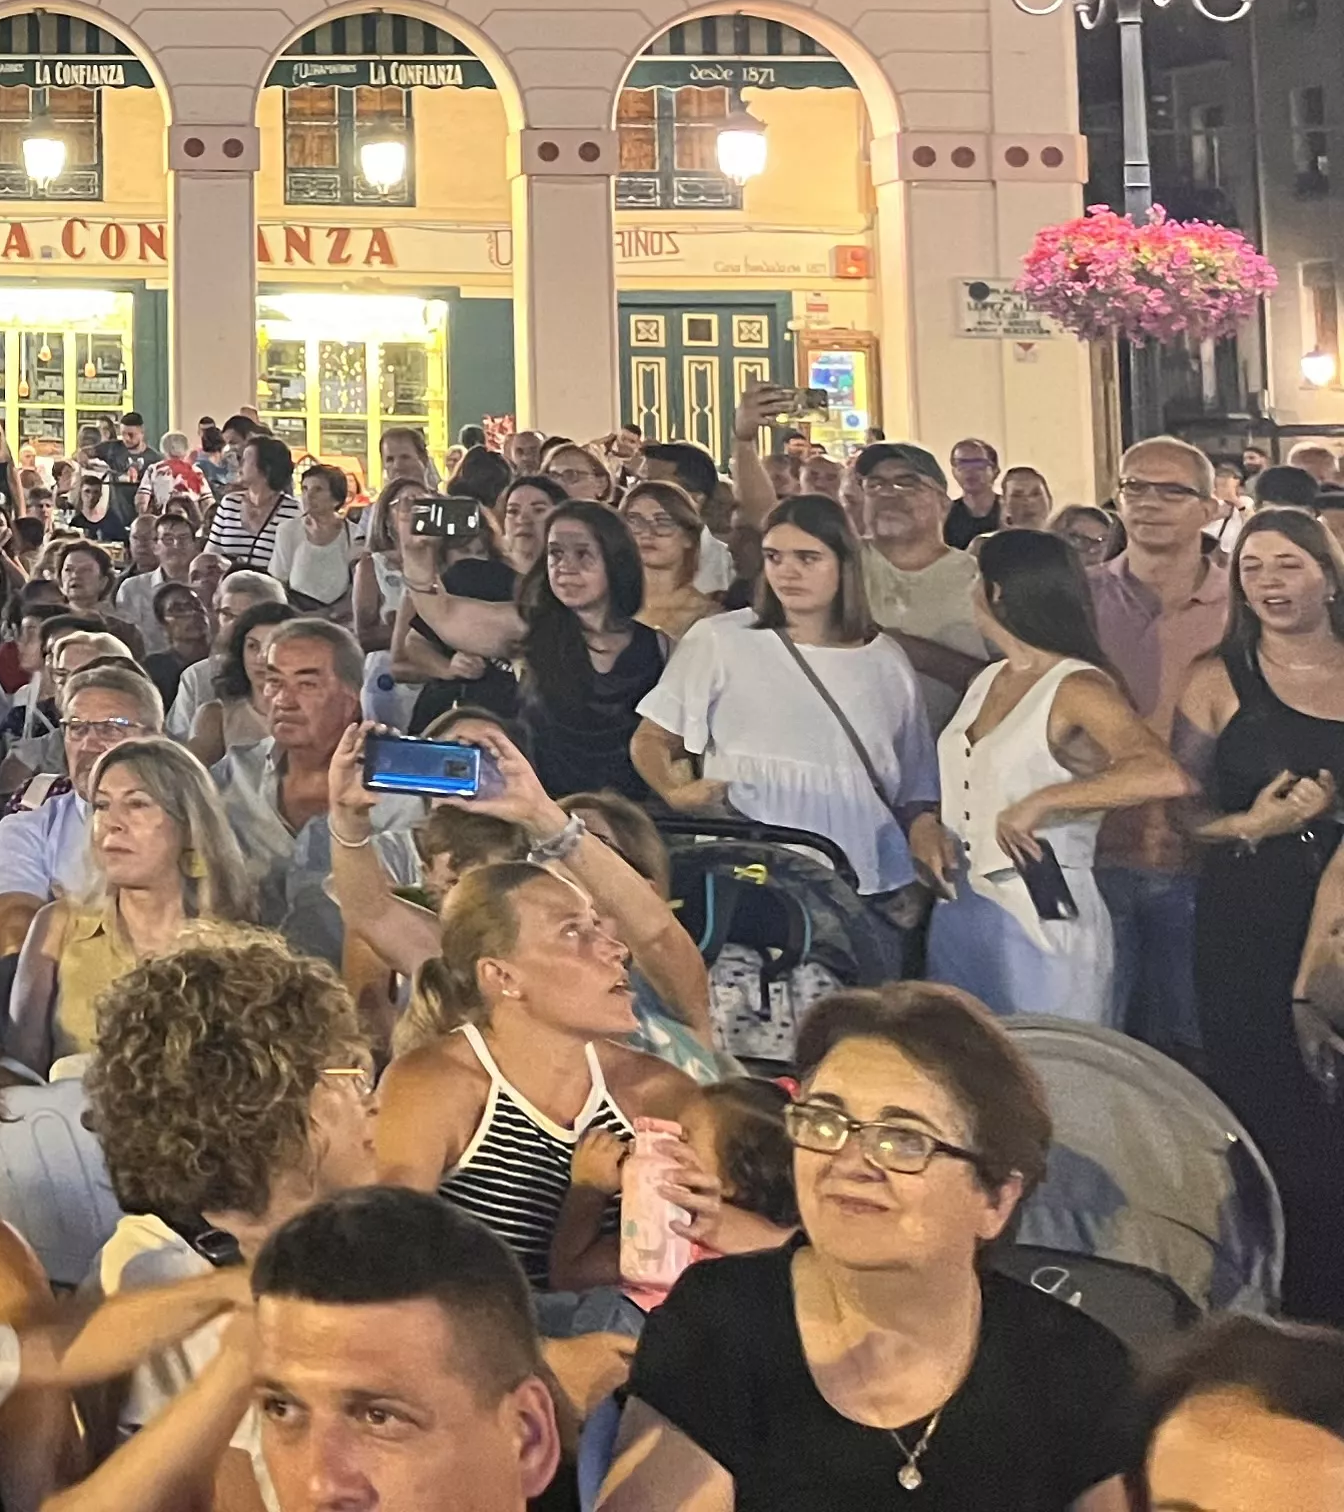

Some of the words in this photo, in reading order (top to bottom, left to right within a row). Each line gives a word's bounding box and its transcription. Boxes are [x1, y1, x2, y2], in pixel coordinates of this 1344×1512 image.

[35, 61, 51, 85] LA
[54, 61, 125, 85] CONFIANZA
[369, 61, 387, 85] LA
[390, 61, 464, 85] CONFIANZA
[689, 63, 734, 81] desde
[742, 67, 776, 85] 1871
